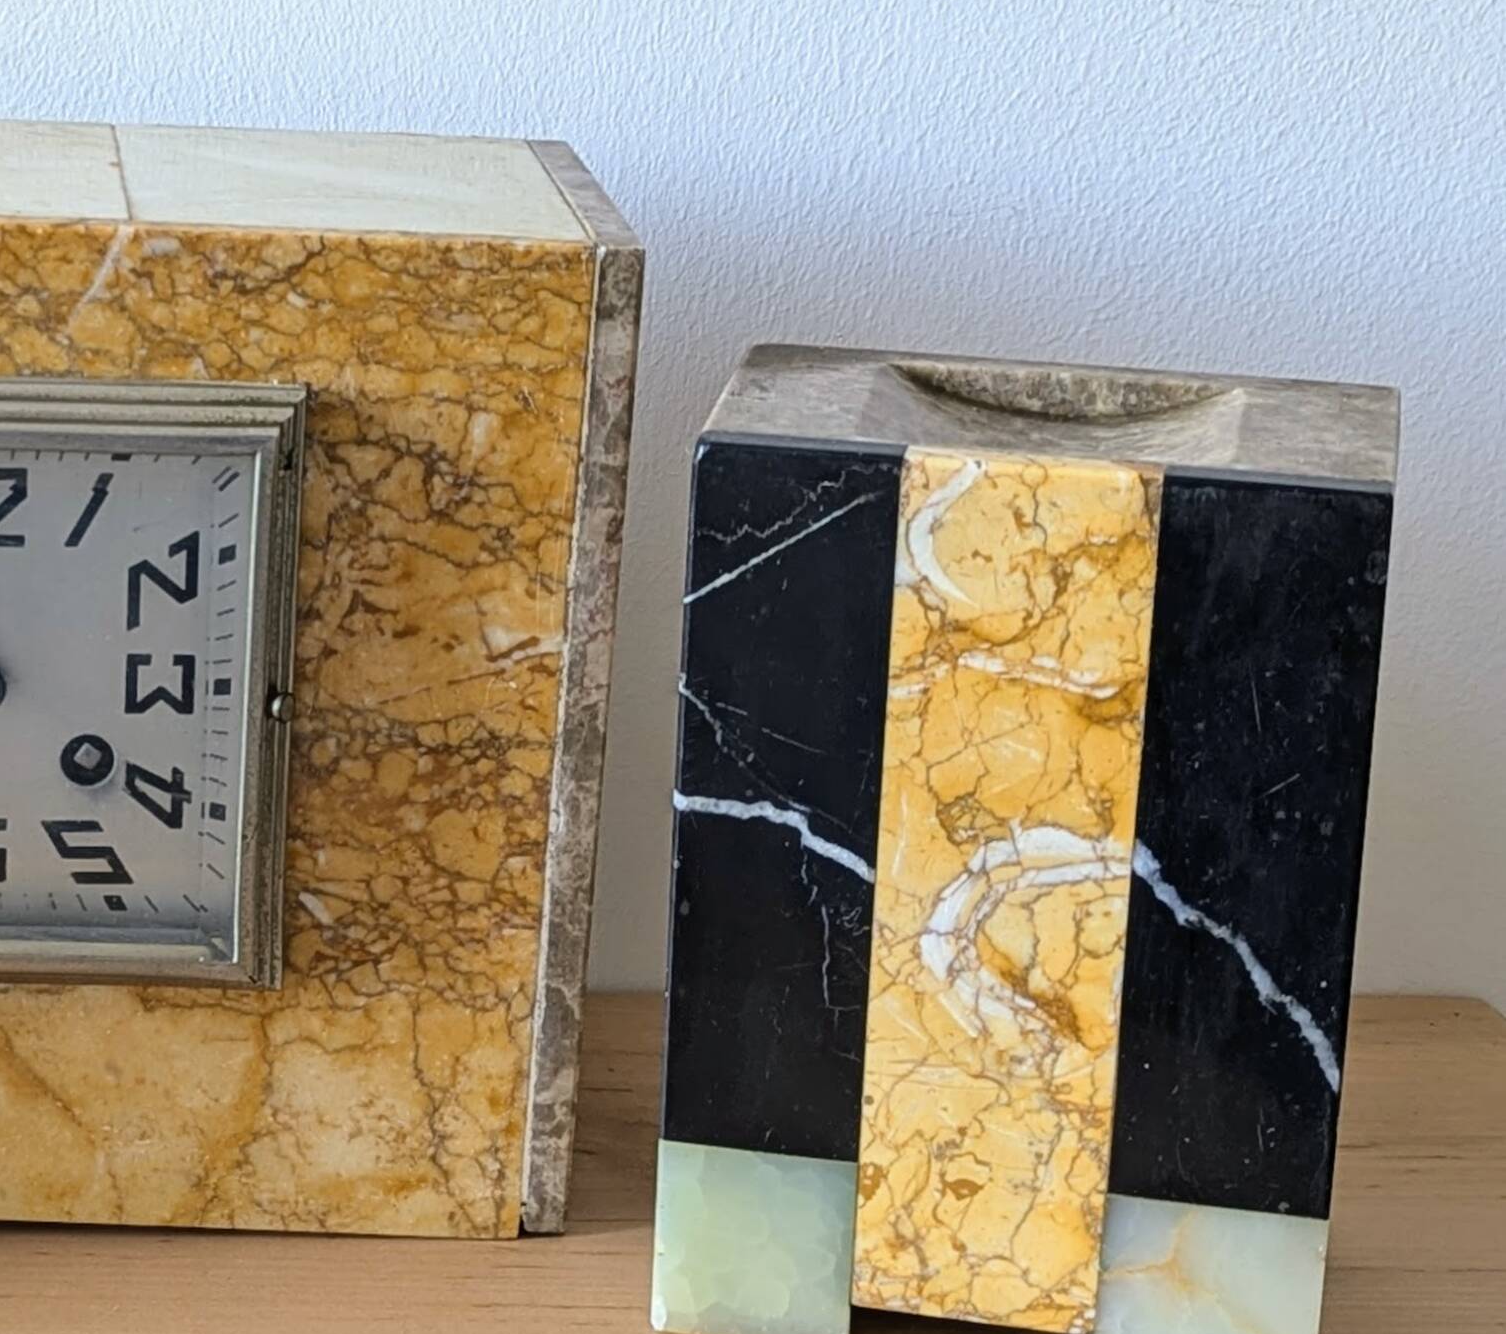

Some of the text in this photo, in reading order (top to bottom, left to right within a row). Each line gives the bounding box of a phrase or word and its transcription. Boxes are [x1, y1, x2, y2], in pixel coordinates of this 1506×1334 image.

[126, 530, 200, 631] 2
[124, 653, 196, 715] 3
[121, 761, 193, 829] 4
[41, 819, 134, 885] 5
